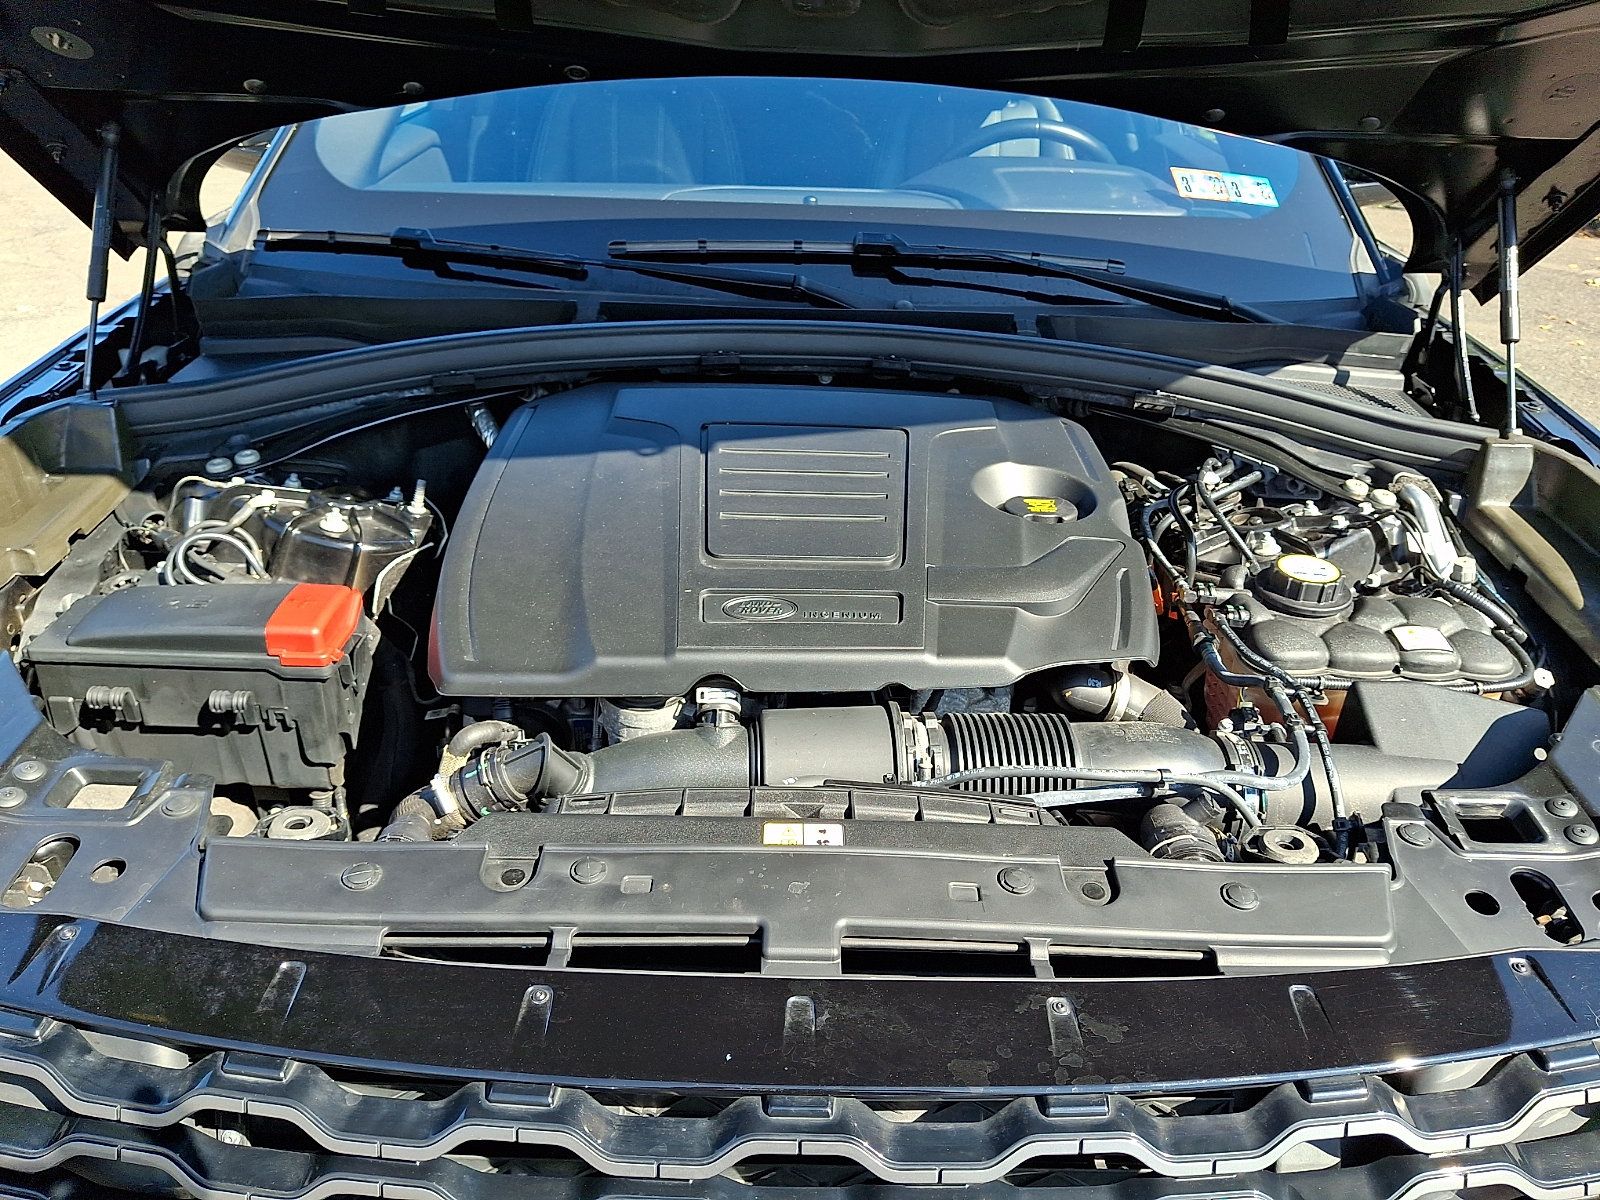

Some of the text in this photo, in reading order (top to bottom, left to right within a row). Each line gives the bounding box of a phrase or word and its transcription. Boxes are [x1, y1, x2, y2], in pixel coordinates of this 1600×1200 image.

[739, 600, 774, 608] LAND
[739, 606, 783, 615] ROVER
[803, 611, 882, 620] INGENIUM
